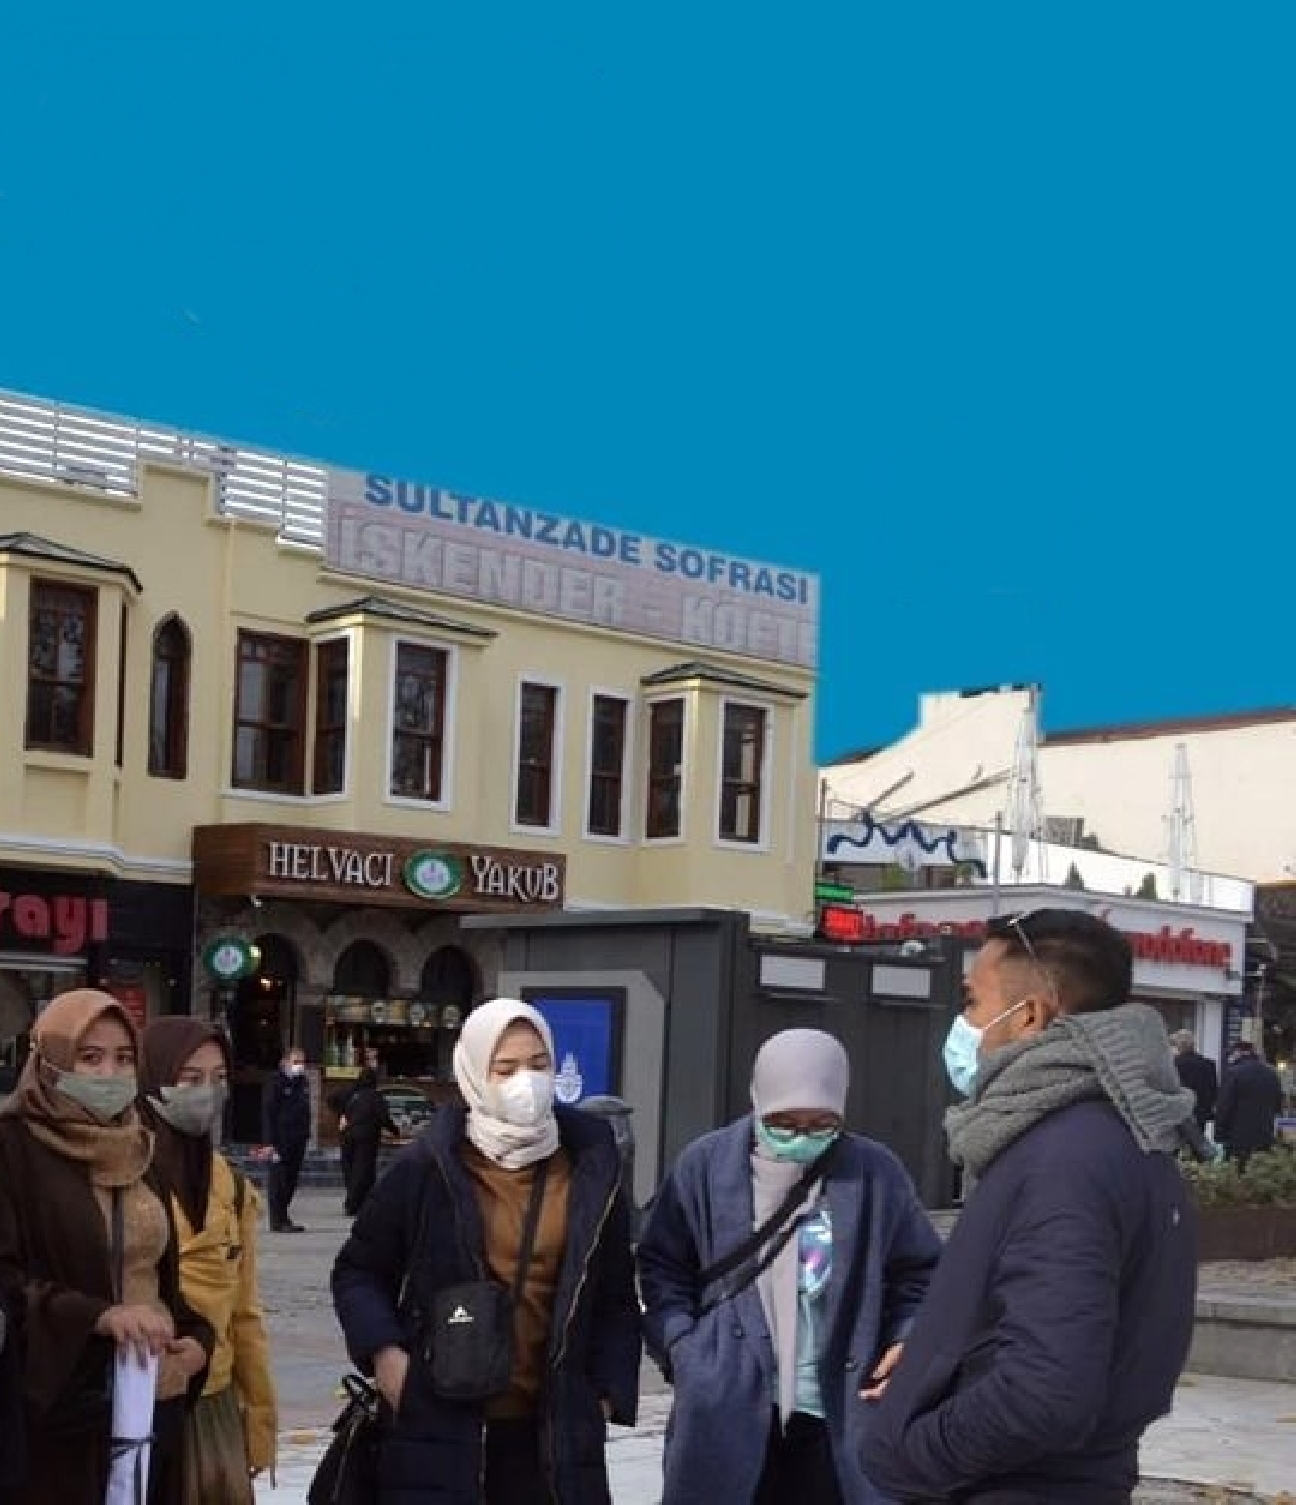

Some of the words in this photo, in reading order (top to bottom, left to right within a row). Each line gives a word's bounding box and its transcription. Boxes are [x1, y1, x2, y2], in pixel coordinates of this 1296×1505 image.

[365, 474, 641, 564] SULTANZADE
[656, 541, 809, 604] SOFRASI
[268, 841, 394, 887] HELVACI
[471, 855, 560, 901] YAKUB
